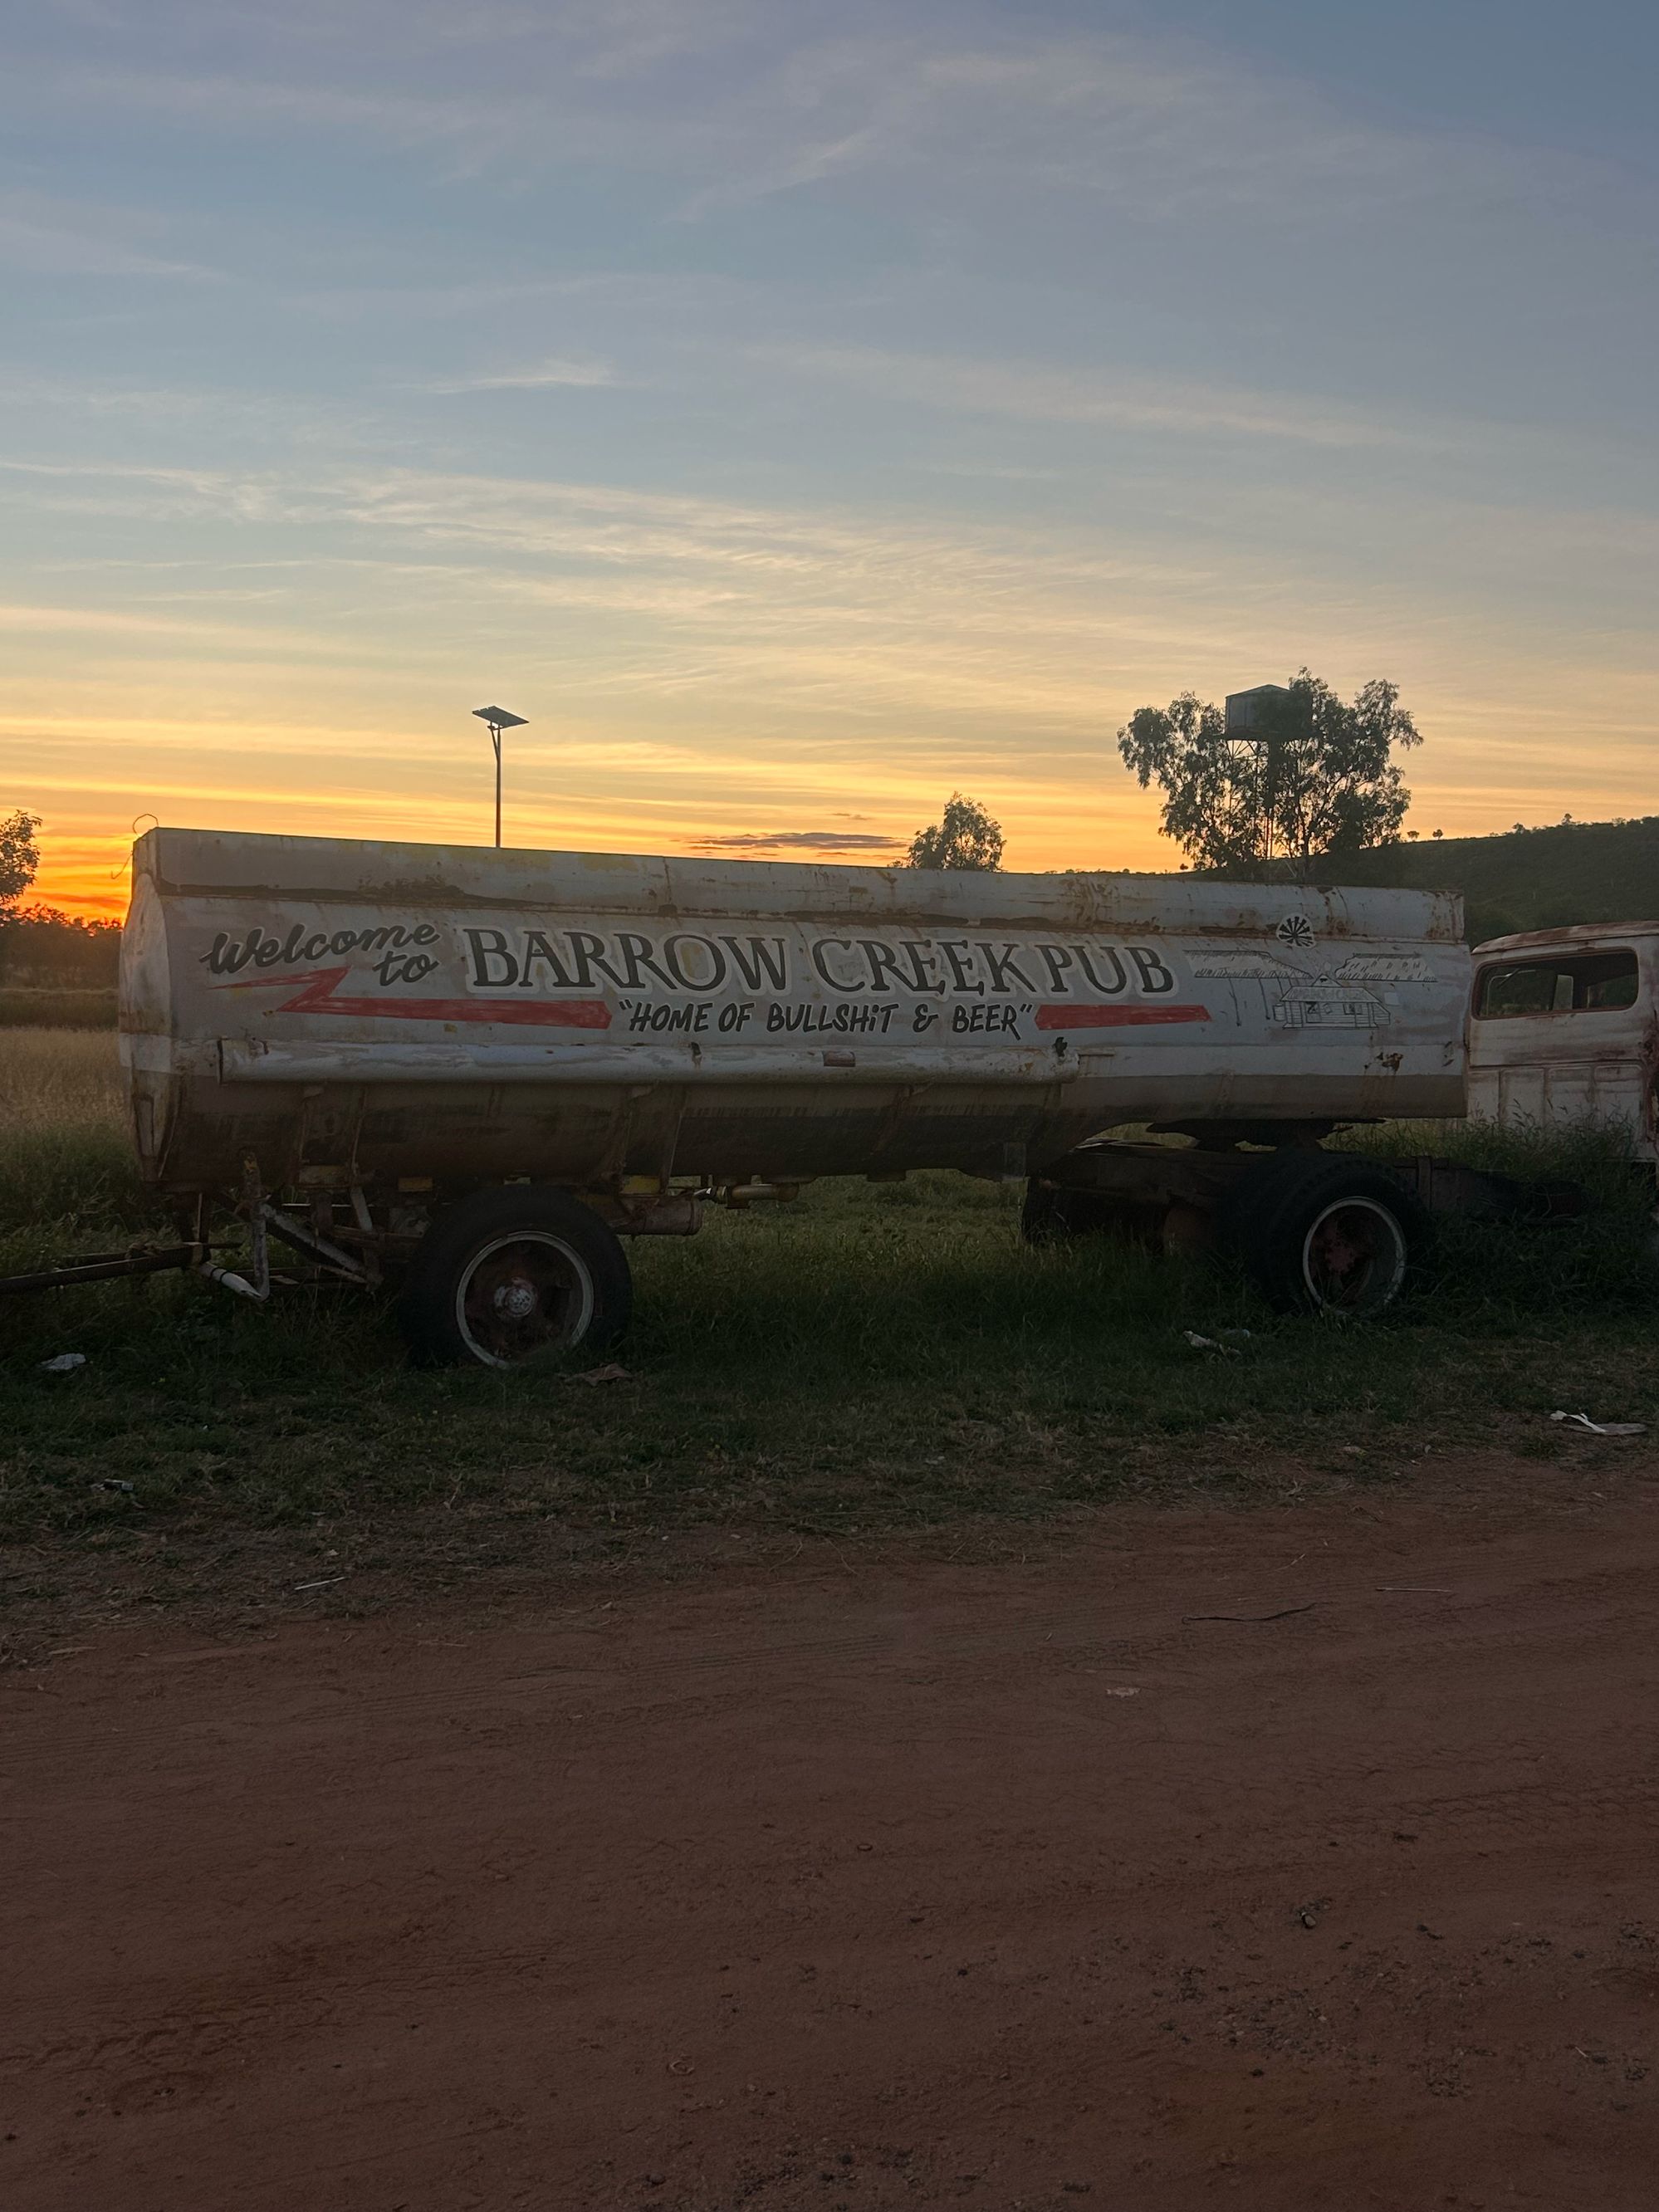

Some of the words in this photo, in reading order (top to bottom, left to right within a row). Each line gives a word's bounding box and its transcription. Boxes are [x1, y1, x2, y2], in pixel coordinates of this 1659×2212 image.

[199, 923, 441, 975] Welcome
[372, 950, 440, 986] to
[462, 927, 787, 992] BARROW
[811, 938, 1038, 996] CREEK
[1035, 943, 1174, 995] PUB
[618, 998, 713, 1033] "HOME
[717, 1001, 756, 1033] OF
[913, 1004, 939, 1033] &
[952, 1003, 1033, 1040] BEER"
